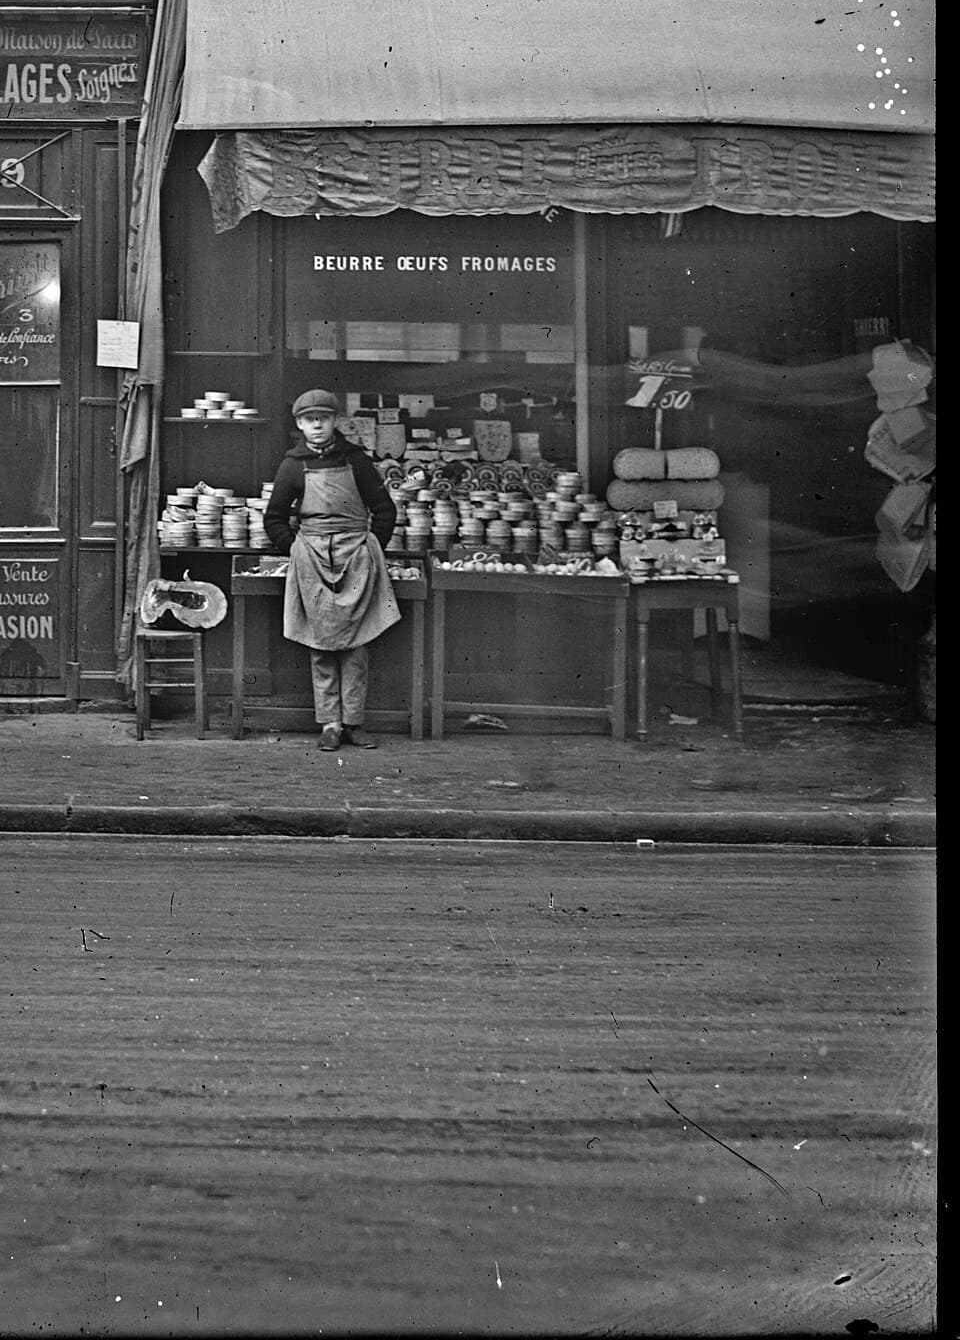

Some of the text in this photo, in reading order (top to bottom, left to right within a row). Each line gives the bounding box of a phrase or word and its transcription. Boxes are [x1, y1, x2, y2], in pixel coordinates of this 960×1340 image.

[65, 28, 85, 51] de
[313, 255, 557, 272] BEURRE ŒUFS FROMAGES
[19, 308, 34, 322] 3
[7, 327, 56, 350] Confiance
[2, 562, 54, 582] Vente
